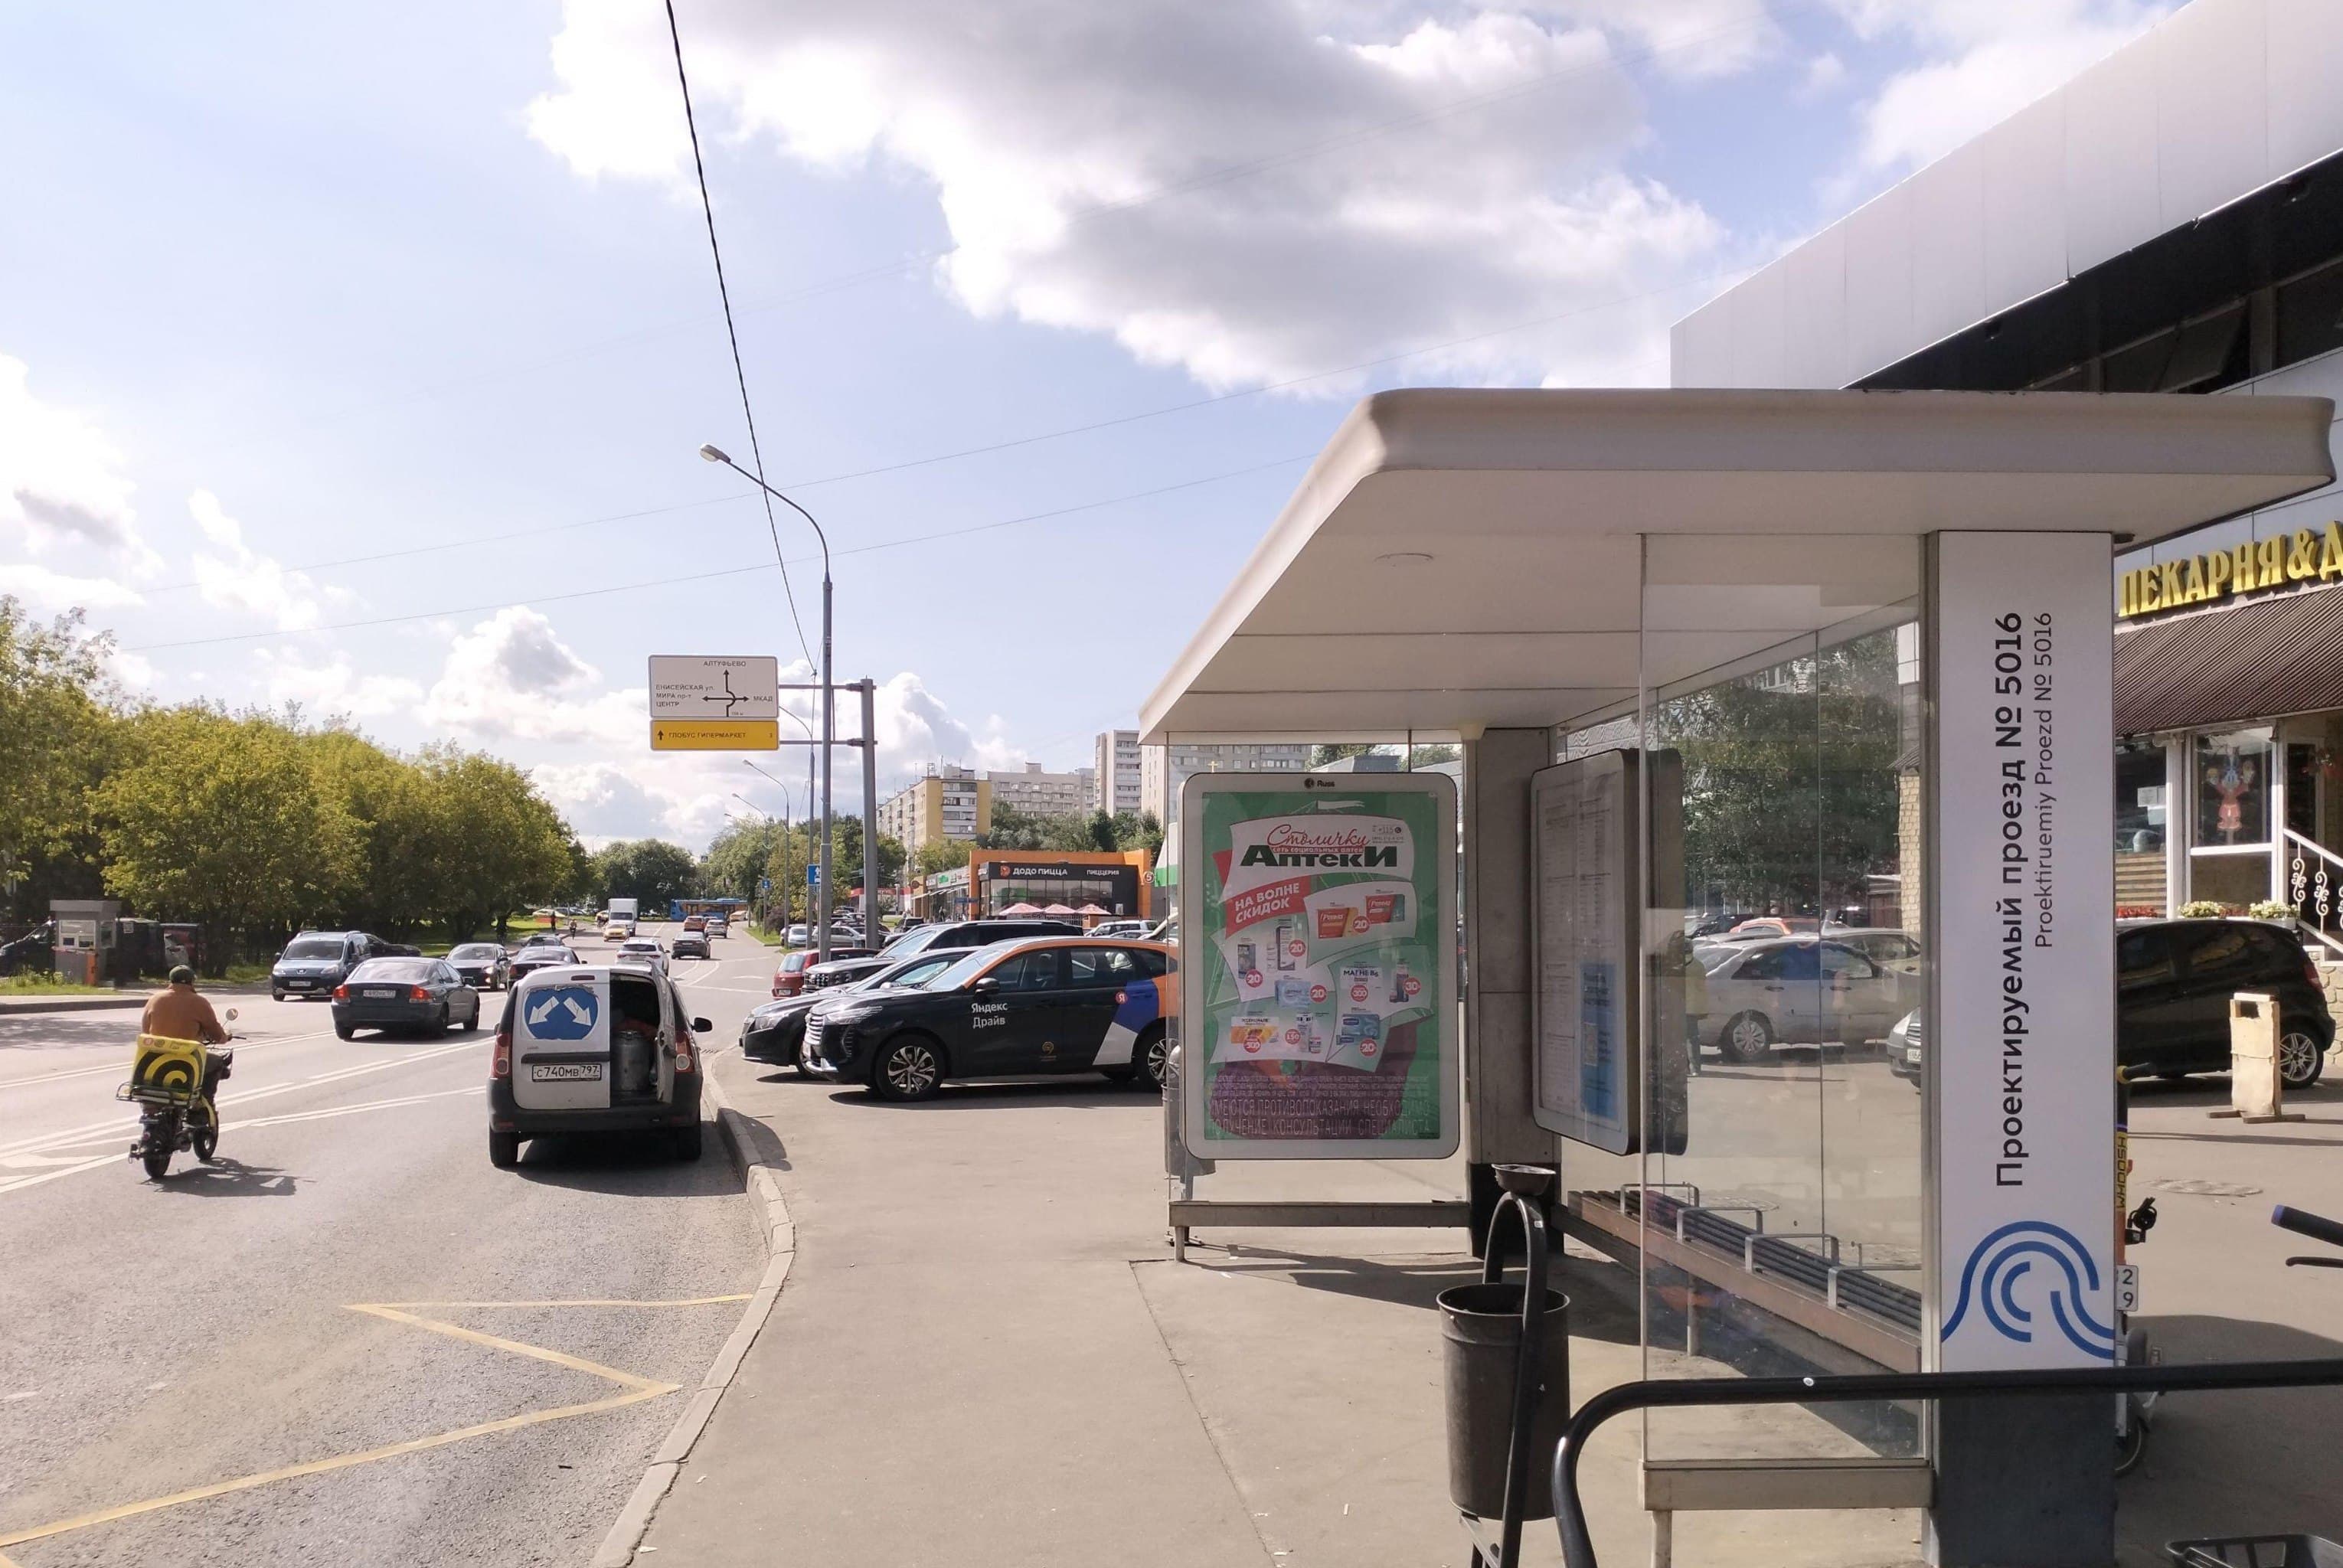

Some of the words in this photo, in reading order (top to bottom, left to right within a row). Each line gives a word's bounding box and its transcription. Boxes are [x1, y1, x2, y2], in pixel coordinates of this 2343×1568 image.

[1995, 612, 2022, 695] 5016
[2034, 612, 2052, 666] 5016
[2034, 674, 2052, 701] №
[1995, 706, 2022, 747] №
[2034, 710, 2053, 785] Proezd
[1267, 824, 1371, 846] Столички
[2002, 760, 2028, 884] проезд
[2034, 792, 2057, 948] Proektiruemiy
[1235, 897, 1253, 911] НА
[1256, 883, 1299, 903] ВОЛНЕ
[1236, 897, 1289, 923] СКИДОК
[971, 1002, 1008, 1014] Яндекс
[972, 1016, 1005, 1029] Драйв
[1995, 898, 2029, 1186] Проектируемый
[581, 1065, 598, 1074] 797
[2116, 1135, 2127, 1209] WHOOSH
